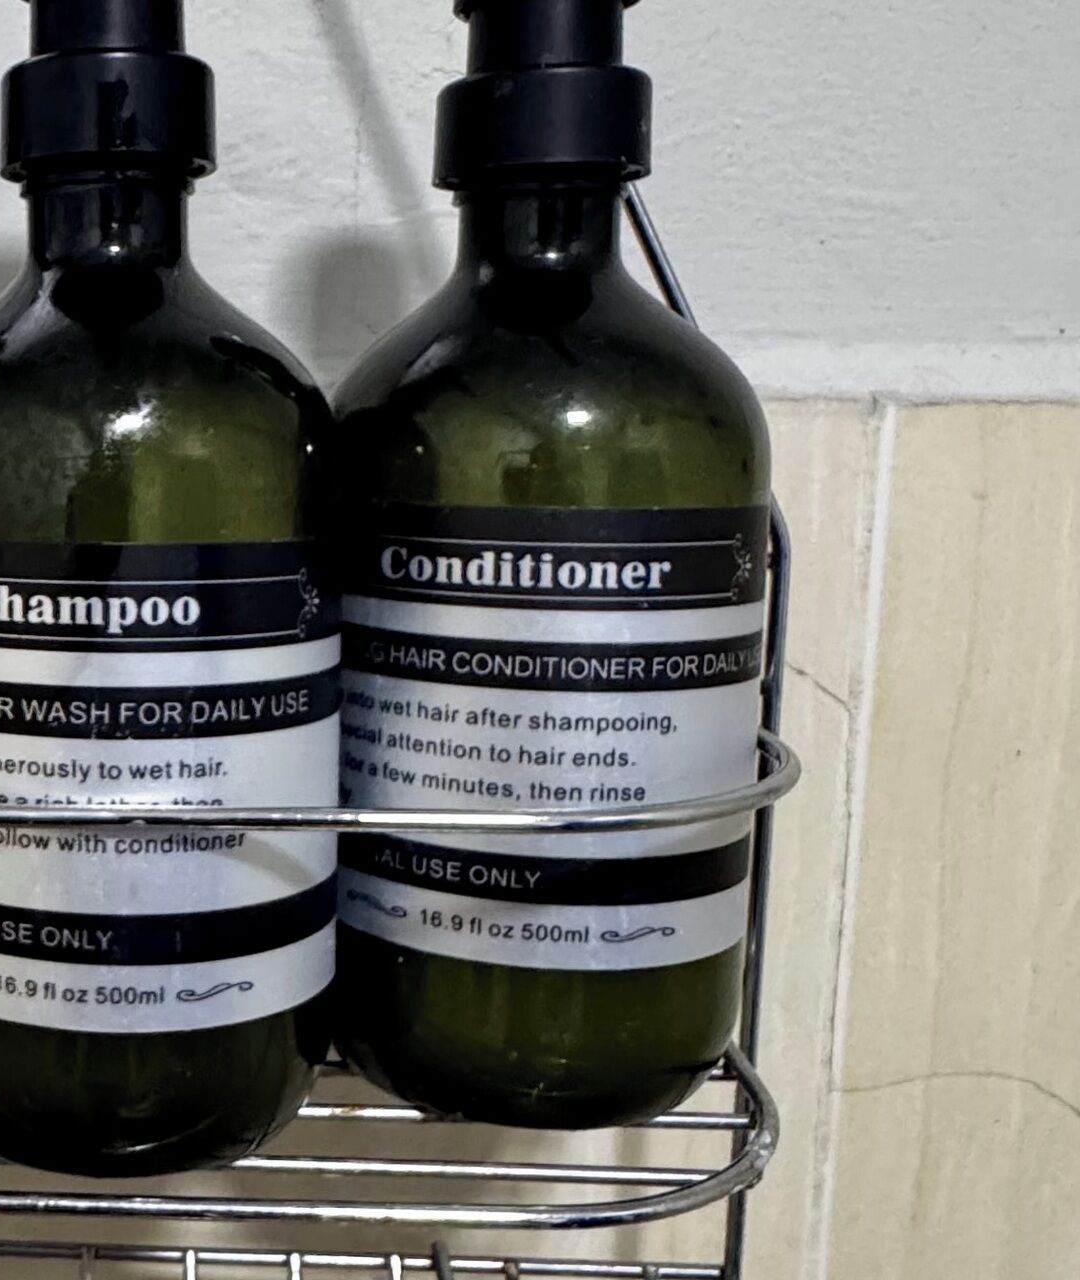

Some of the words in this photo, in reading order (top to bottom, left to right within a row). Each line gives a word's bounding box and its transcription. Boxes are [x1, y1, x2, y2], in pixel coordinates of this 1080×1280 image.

[380, 545, 672, 590] Conditioner
[389, 644, 447, 671] HAIR
[452, 651, 645, 680] CONDITIONER
[651, 653, 699, 679] FOR
[703, 649, 747, 676] DAILY
[21, 698, 111, 725] WASH
[119, 701, 183, 725] FOR
[191, 695, 266, 724] DAILY
[271, 688, 309, 717] USE
[379, 699, 412, 717] wet
[417, 700, 460, 723] hair
[465, 708, 523, 730] after
[527, 711, 678, 736] shampooing,
[386, 732, 482, 761] attention
[489, 744, 511, 764] to
[517, 745, 566, 766] hair
[572, 747, 637, 768] ends.
[99, 761, 123, 780] to
[129, 763, 173, 780] wet
[178, 757, 228, 780] hair.
[368, 763, 378, 777] a
[381, 762, 416, 784] few
[421, 771, 521, 802] minutes,
[529, 781, 583, 802] then
[589, 782, 645, 802] rinse
[57, 832, 107, 854] with
[113, 831, 246, 855] conditioner
[411, 857, 462, 882] USE
[469, 865, 542, 889] ONLY
[40, 926, 113, 951] ONLY
[420, 908, 464, 932] 16.9
[469, 916, 482, 935] fl
[487, 924, 514, 939] oz
[521, 922, 590, 943] 500ml
[43, 981, 56, 1001] fl
[62, 987, 88, 1003] oz
[94, 985, 166, 1005] 500ml
